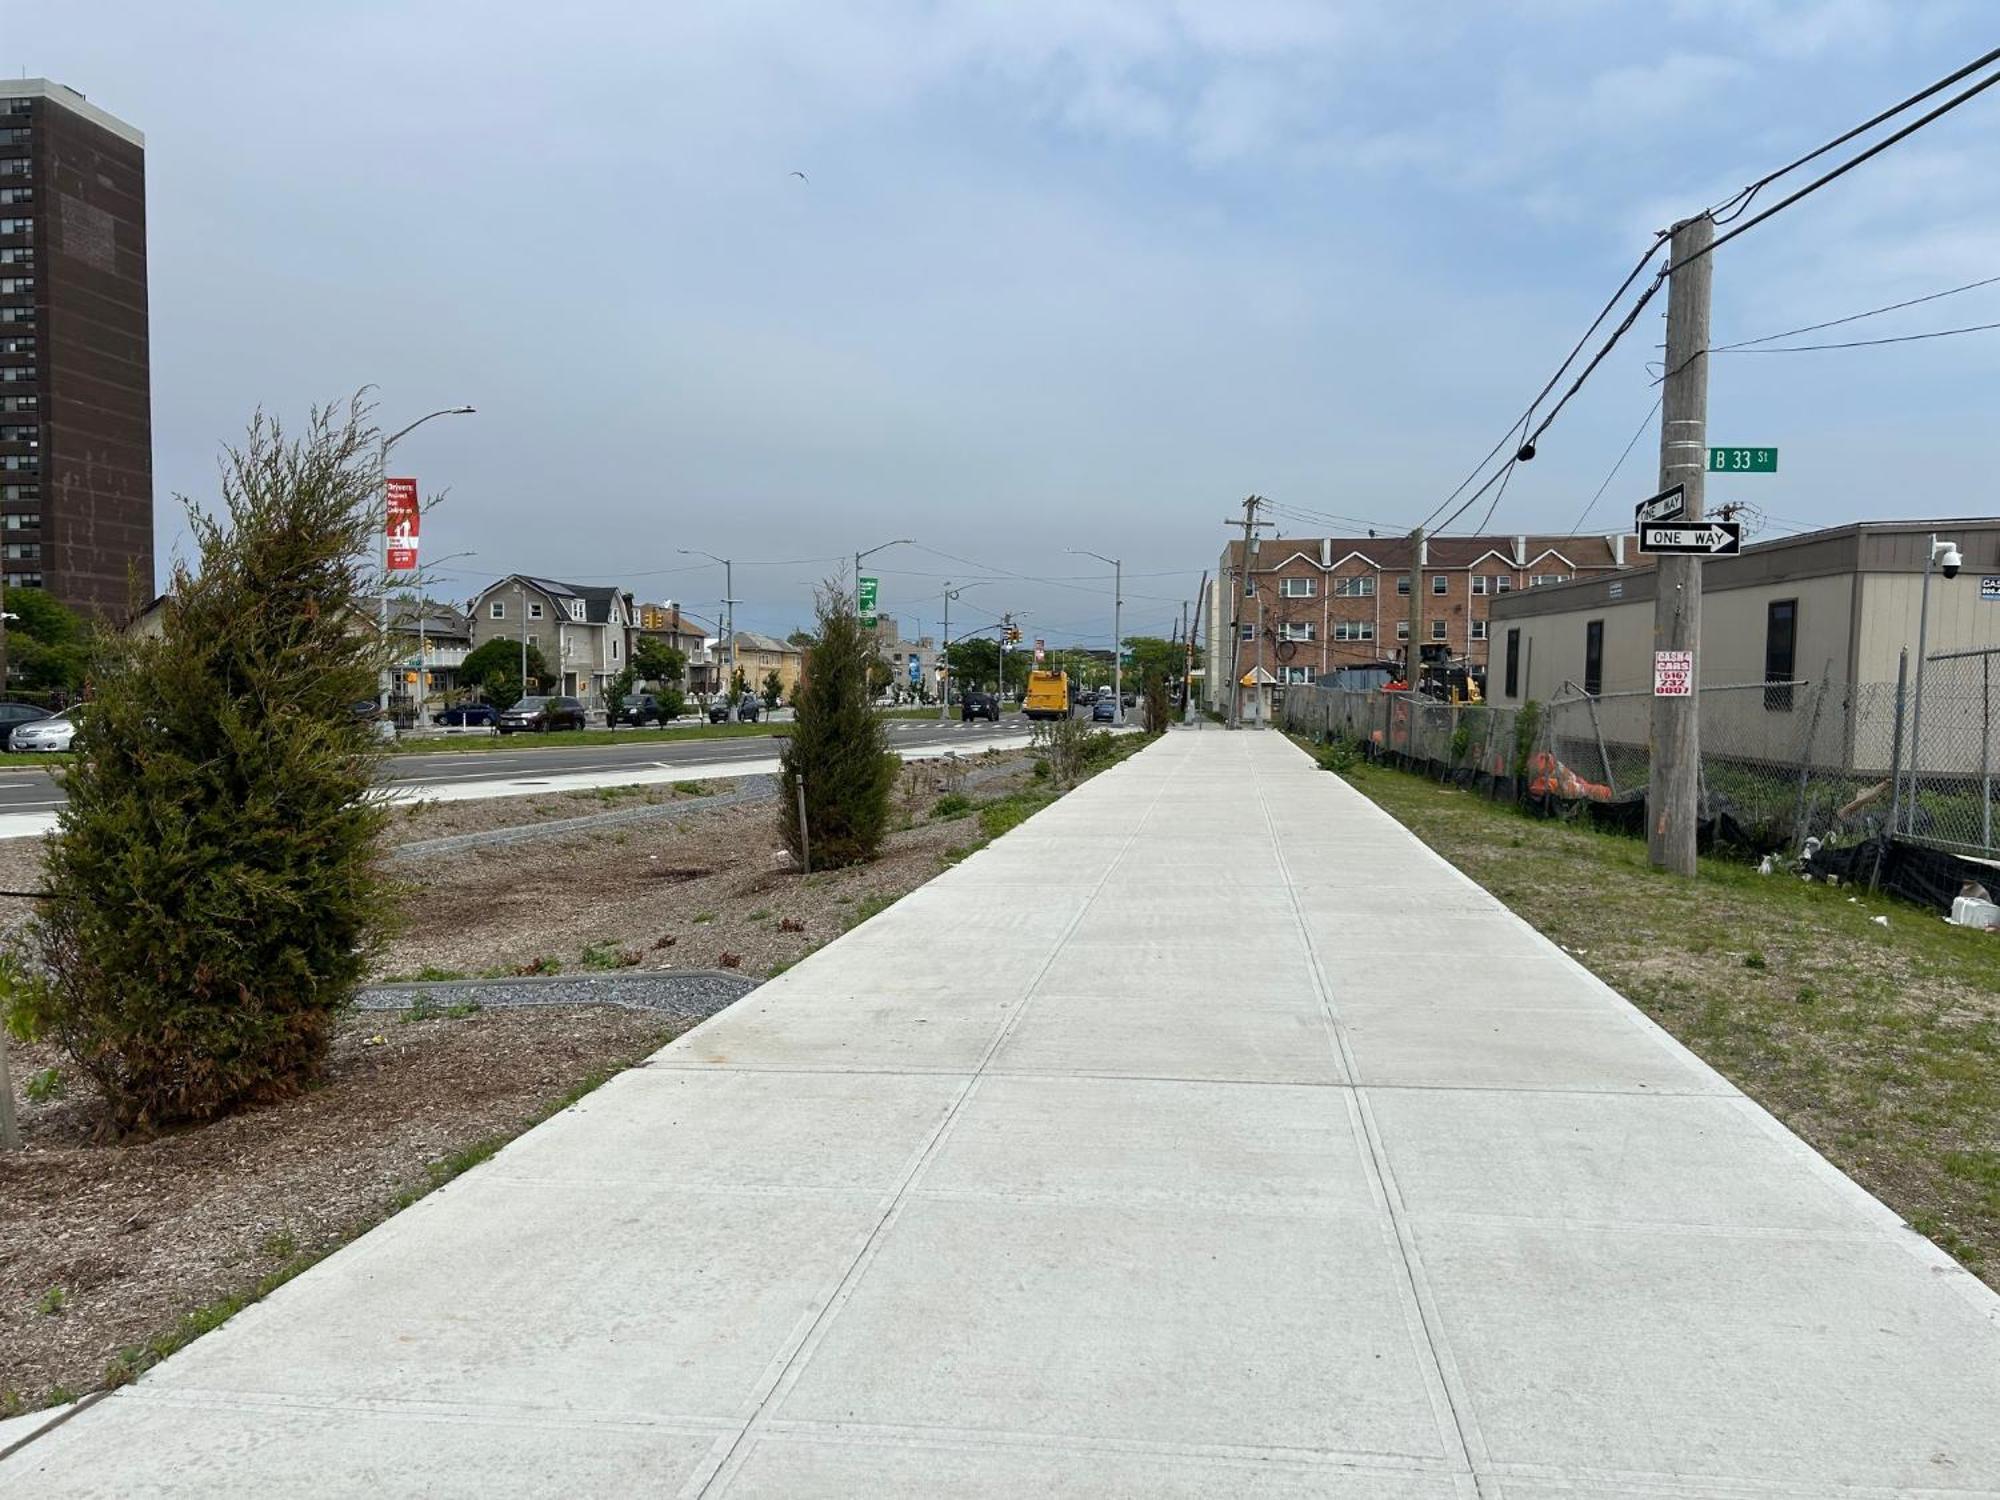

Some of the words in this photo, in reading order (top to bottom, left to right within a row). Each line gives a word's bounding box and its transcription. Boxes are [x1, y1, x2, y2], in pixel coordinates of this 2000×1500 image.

[1716, 451, 1725, 468] B
[1733, 451, 1750, 468] 33
[1664, 494, 1680, 512] WAY
[1654, 532, 1681, 544] ONE
[1695, 532, 1724, 545] WAY
[1657, 662, 1689, 670] CARS
